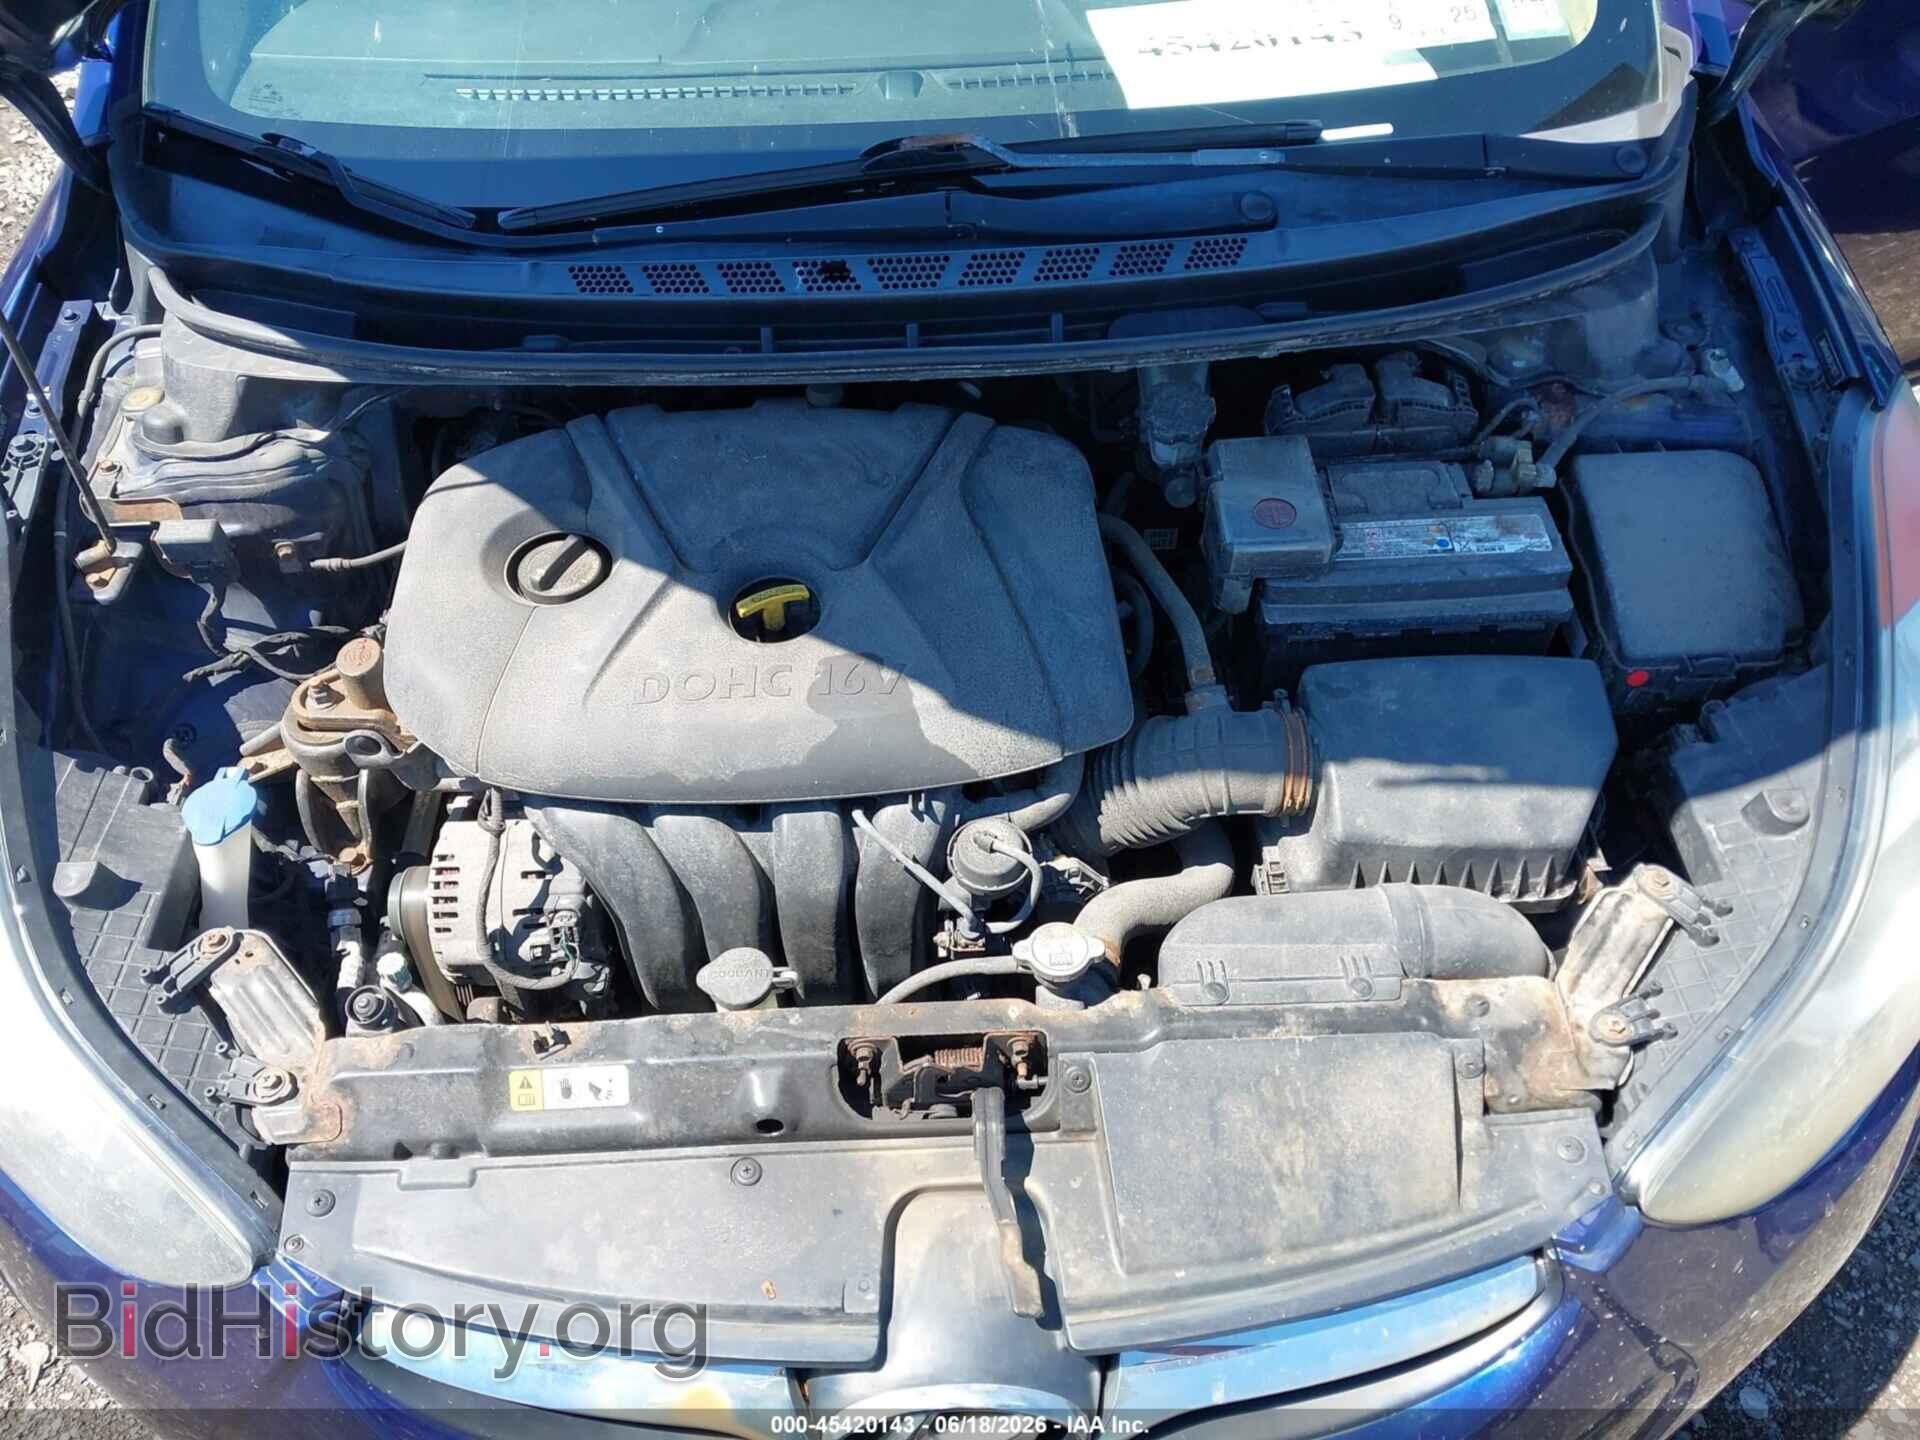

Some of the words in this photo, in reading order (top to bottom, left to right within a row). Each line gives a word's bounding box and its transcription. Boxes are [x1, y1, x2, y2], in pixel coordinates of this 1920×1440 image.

[633, 664, 792, 704] DOHC
[816, 661, 908, 697] 16V
[711, 966, 770, 979] COOLANT
